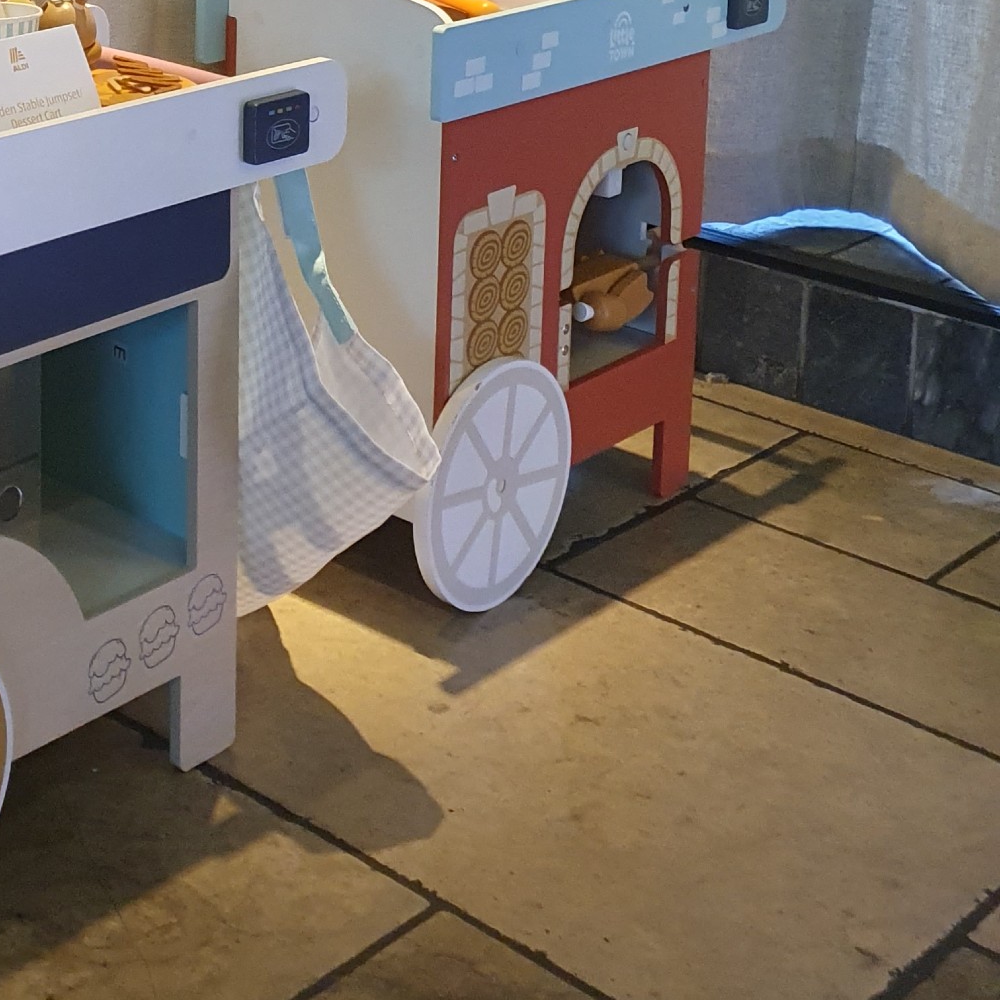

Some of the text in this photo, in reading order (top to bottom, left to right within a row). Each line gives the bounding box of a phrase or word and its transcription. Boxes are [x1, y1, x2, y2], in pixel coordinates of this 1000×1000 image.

[13, 62, 29, 73] ALDI
[17, 96, 45, 113] Stable
[10, 108, 63, 129] Dessert Cart
